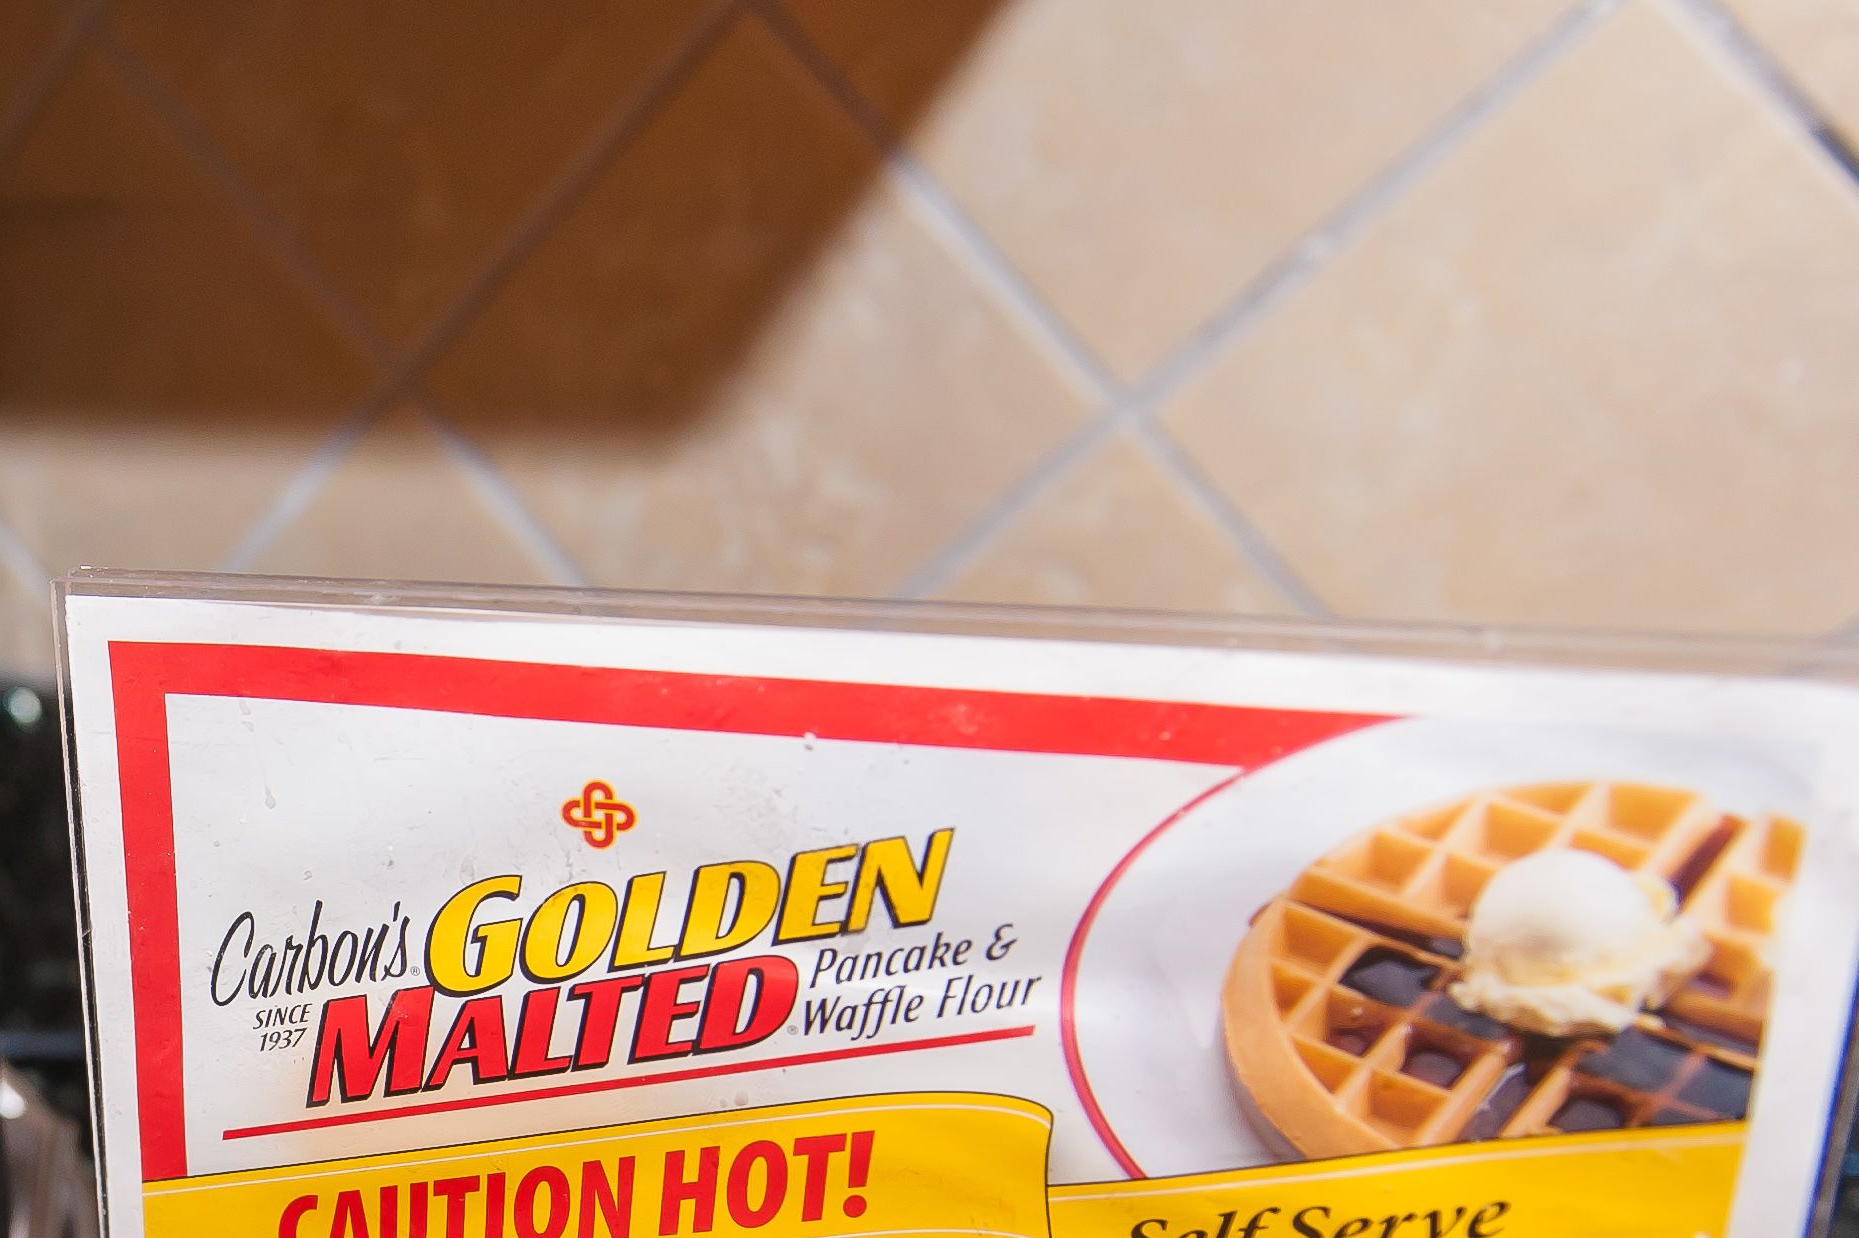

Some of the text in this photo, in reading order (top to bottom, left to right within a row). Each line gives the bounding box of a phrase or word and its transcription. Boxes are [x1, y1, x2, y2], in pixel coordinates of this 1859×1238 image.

[210, 827, 955, 1007] Carbon's GOLDEN
[810, 923, 1015, 990] Pancake &
[253, 1004, 310, 1030] SINCE
[258, 1026, 309, 1052] 1937
[307, 956, 799, 1107] MALTED
[801, 971, 1041, 1043] Waffle Flour
[659, 1131, 874, 1236] HOT!
